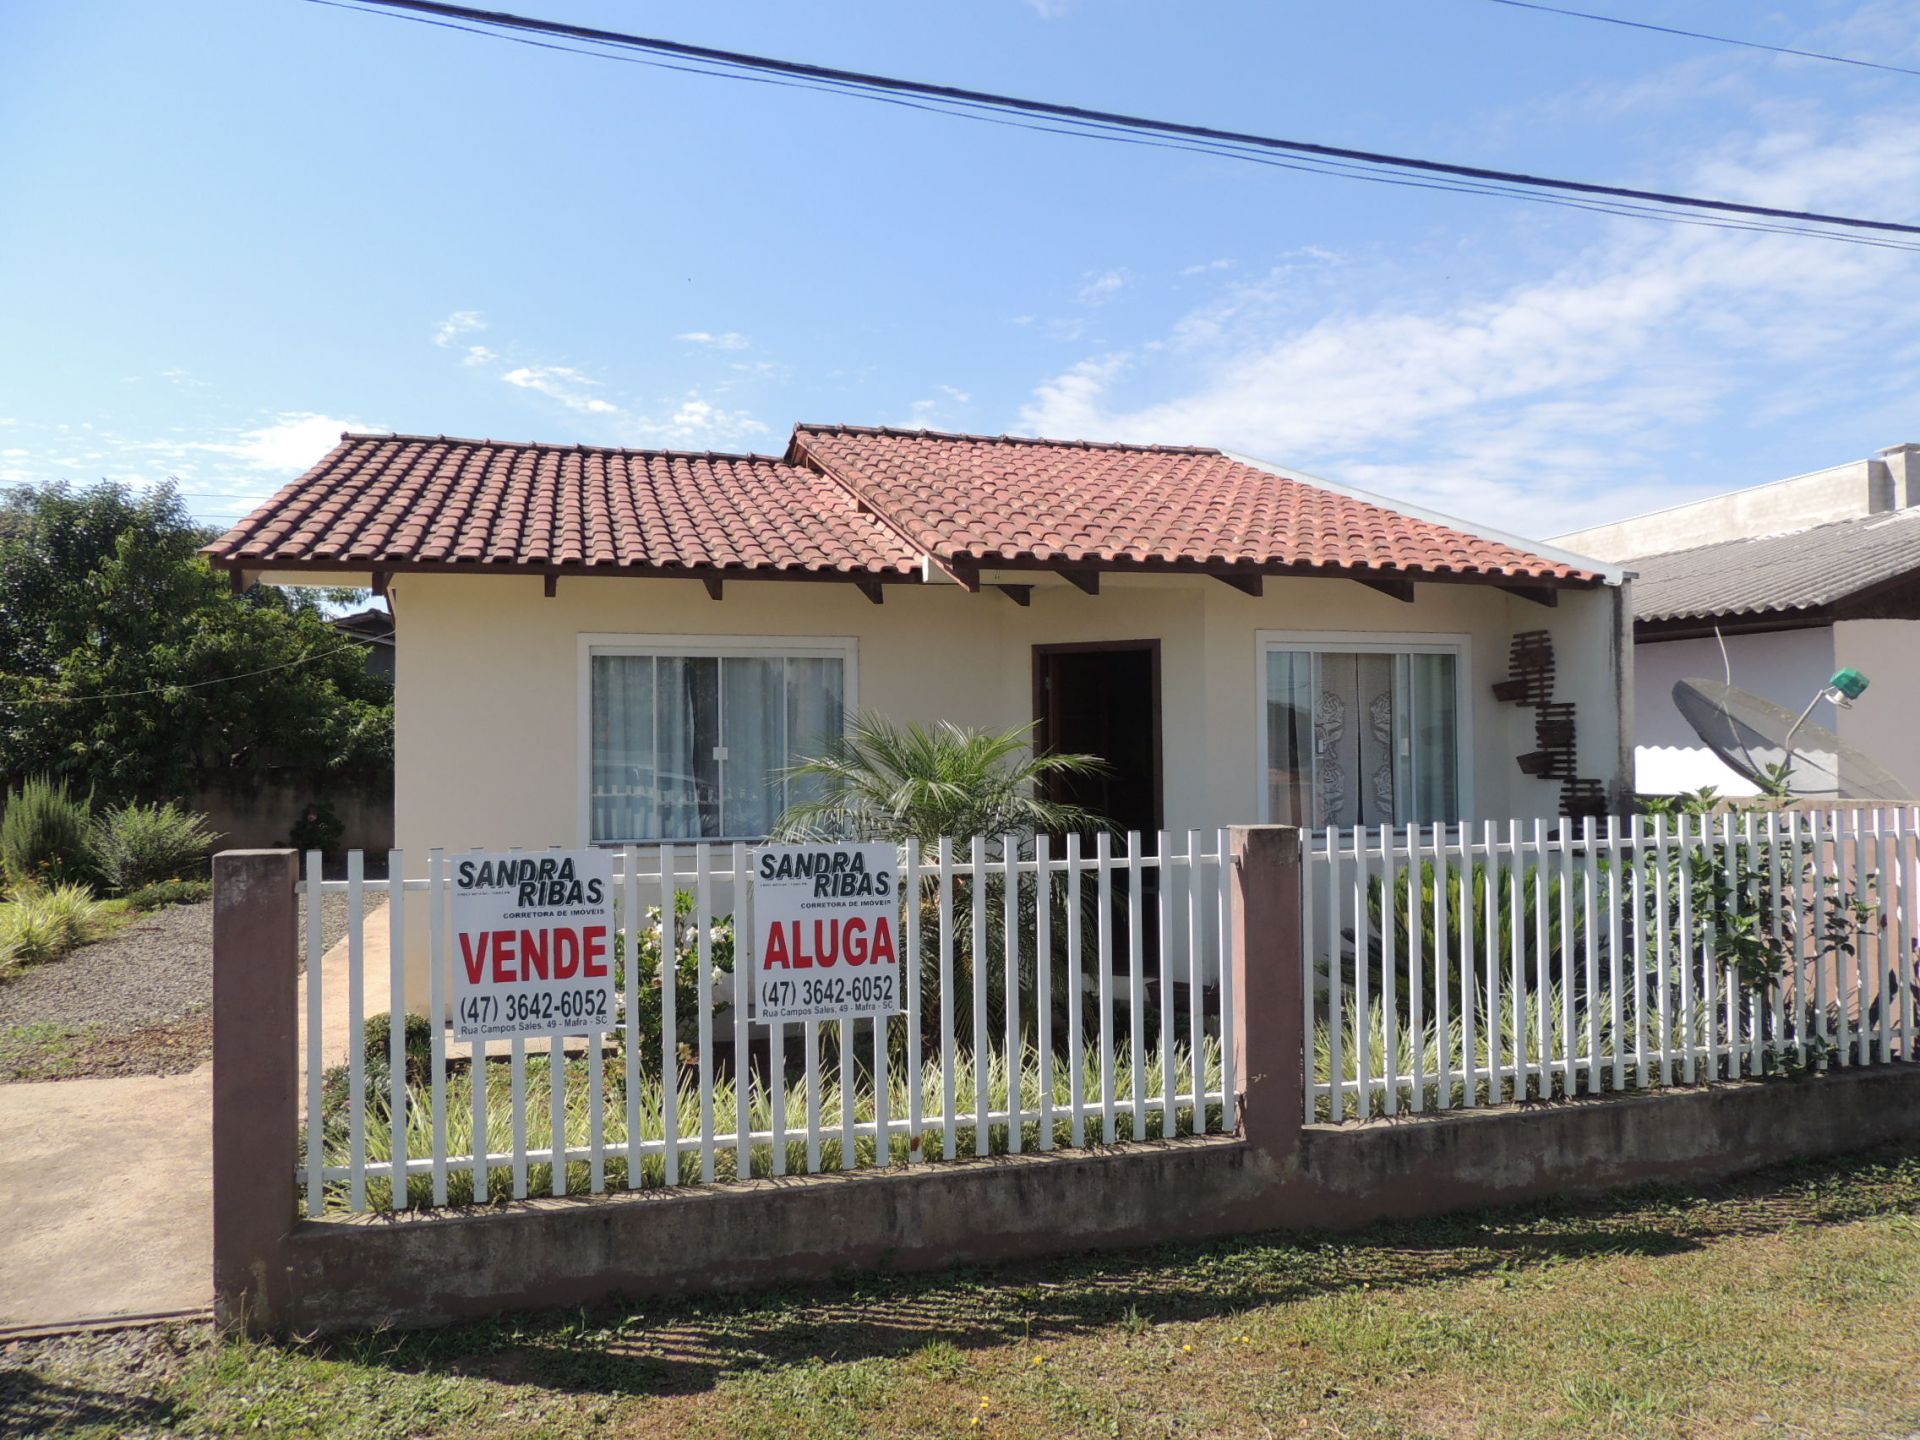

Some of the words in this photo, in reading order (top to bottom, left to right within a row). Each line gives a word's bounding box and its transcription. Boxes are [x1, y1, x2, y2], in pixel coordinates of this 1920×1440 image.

[458, 858, 576, 889] SANDRA
[760, 852, 866, 880] SANDRA
[518, 878, 604, 908] RIBAS
[814, 871, 890, 898] RIBAS
[503, 911, 554, 919] CORRETORA
[459, 926, 607, 984] VENDE
[763, 917, 896, 970] ALUGA
[763, 981, 796, 1007] (47)
[803, 975, 893, 1005] 3642-6052
[461, 996, 498, 1024] (47)
[506, 989, 607, 1021] 3642-6052
[763, 1009, 778, 1017] Rua
[780, 1008, 812, 1017] Campos
[855, 1003, 876, 1011] Mafra
[883, 1001, 893, 1009] SC
[461, 1027, 478, 1035] Rua
[481, 1023, 516, 1034] Campos
[547, 1020, 556, 1028] 49
[564, 1018, 587, 1027] Mafra
[596, 1016, 607, 1024] SC
